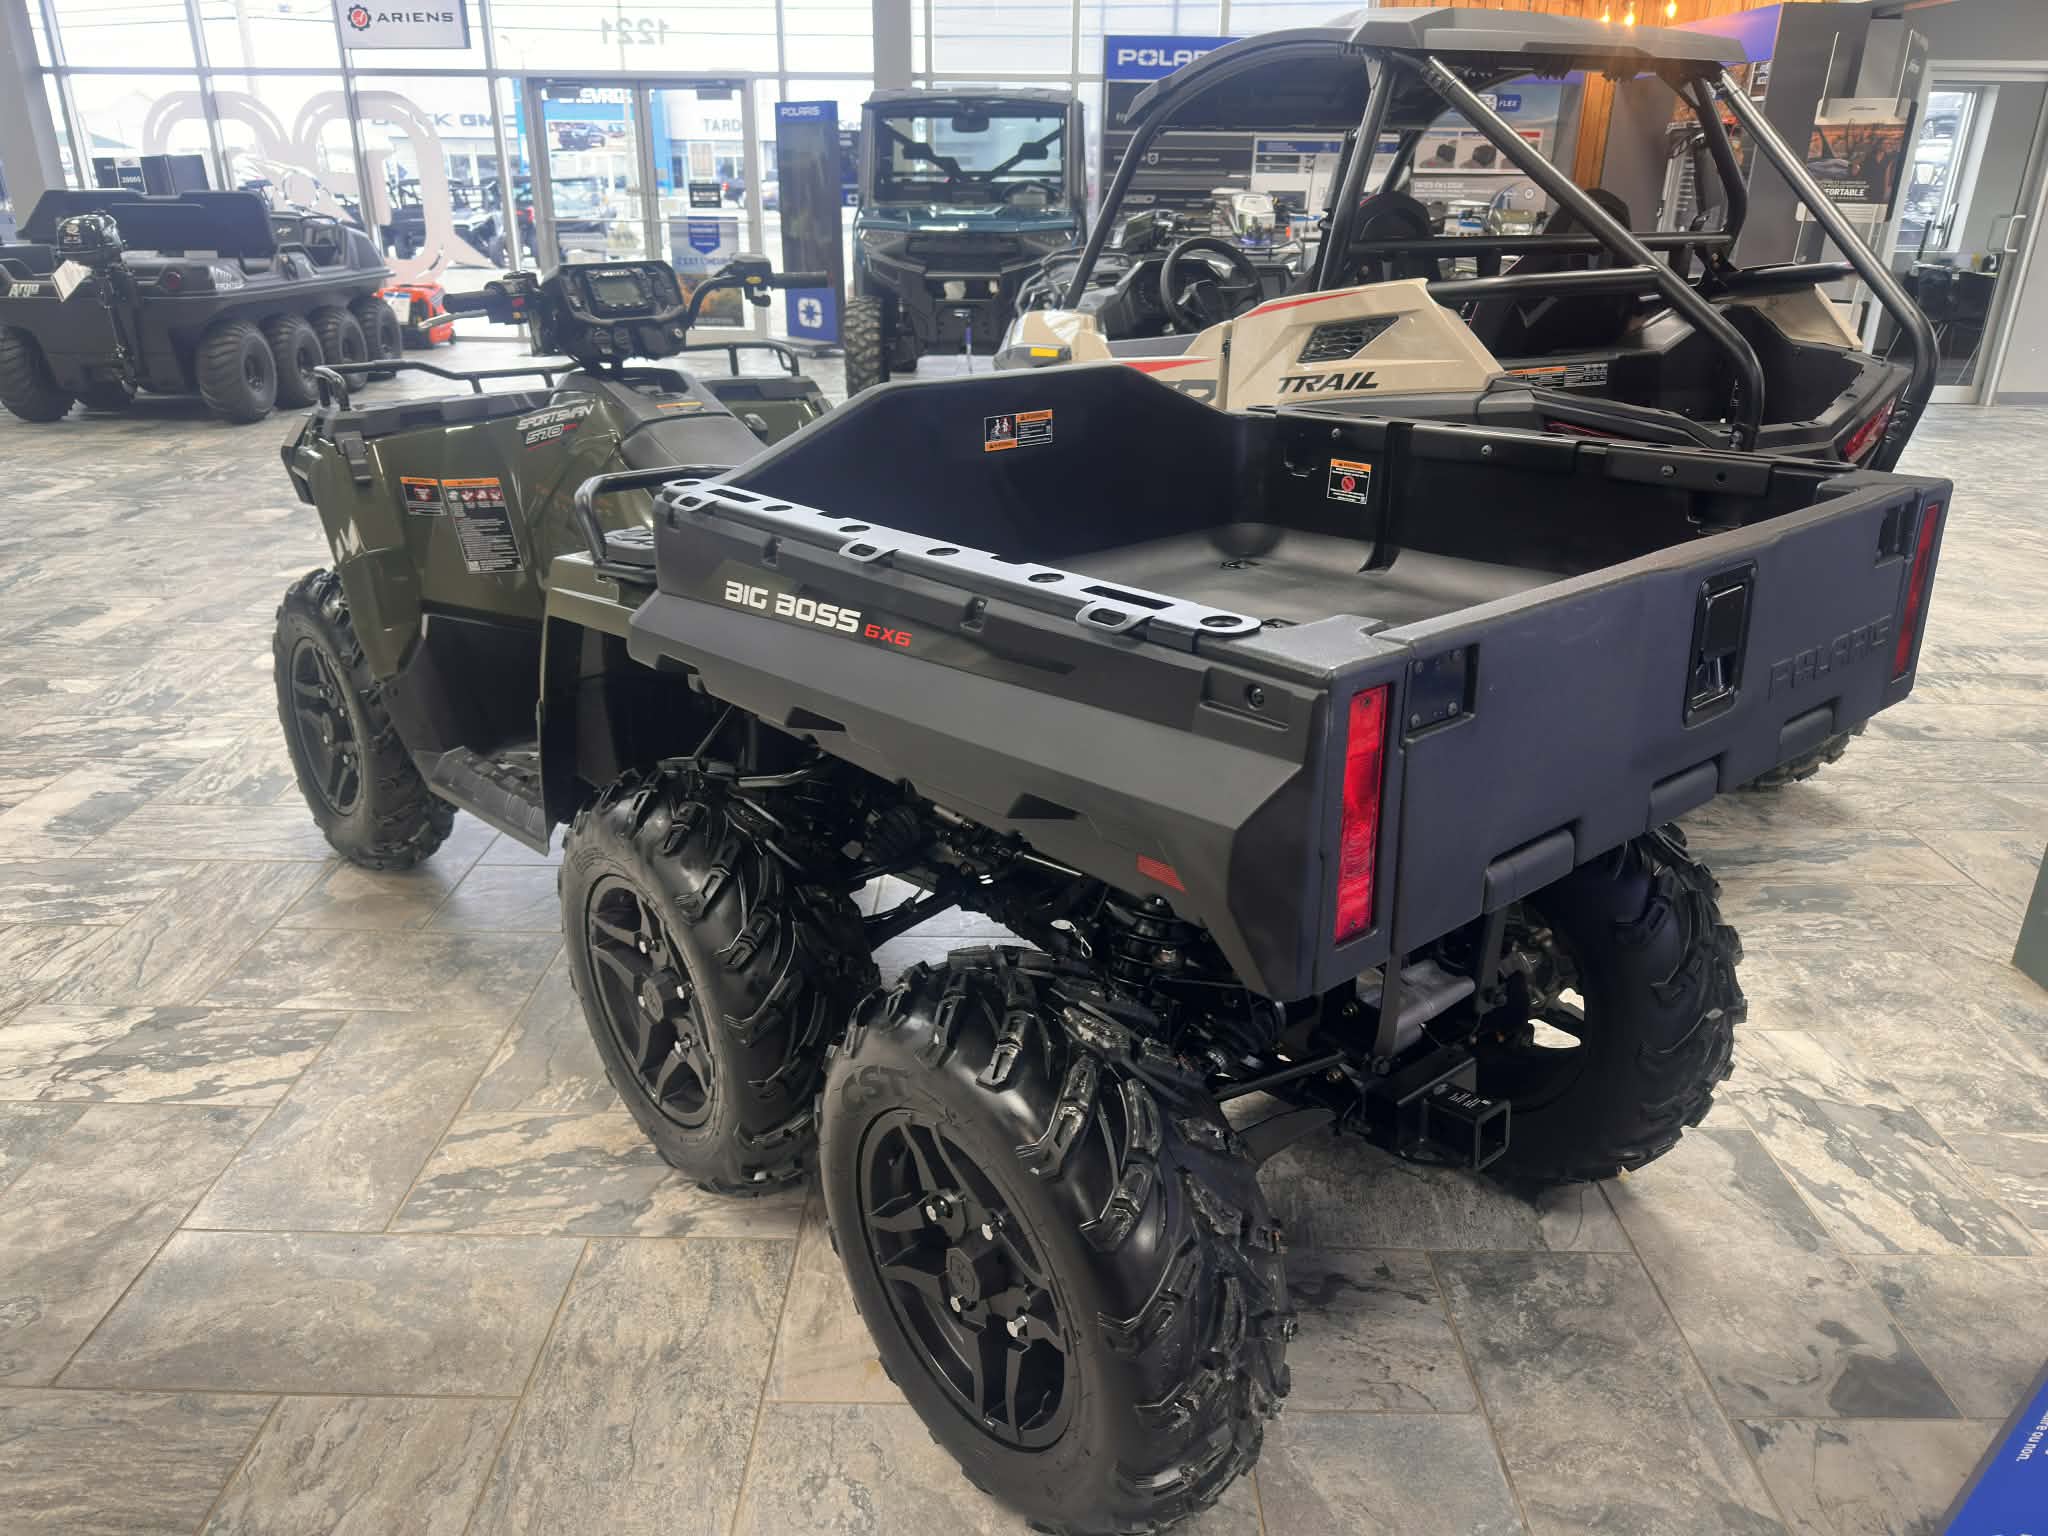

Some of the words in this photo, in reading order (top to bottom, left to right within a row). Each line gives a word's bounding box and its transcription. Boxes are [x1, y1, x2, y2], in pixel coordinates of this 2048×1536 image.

[377, 12, 454, 22] ARIENS
[780, 105, 820, 117] POLARIS
[1277, 371, 1379, 393] TRAIL
[724, 580, 769, 610] BIG
[774, 592, 862, 633] BOSS
[864, 623, 913, 647] 6X6
[841, 1064, 913, 1104] CST
